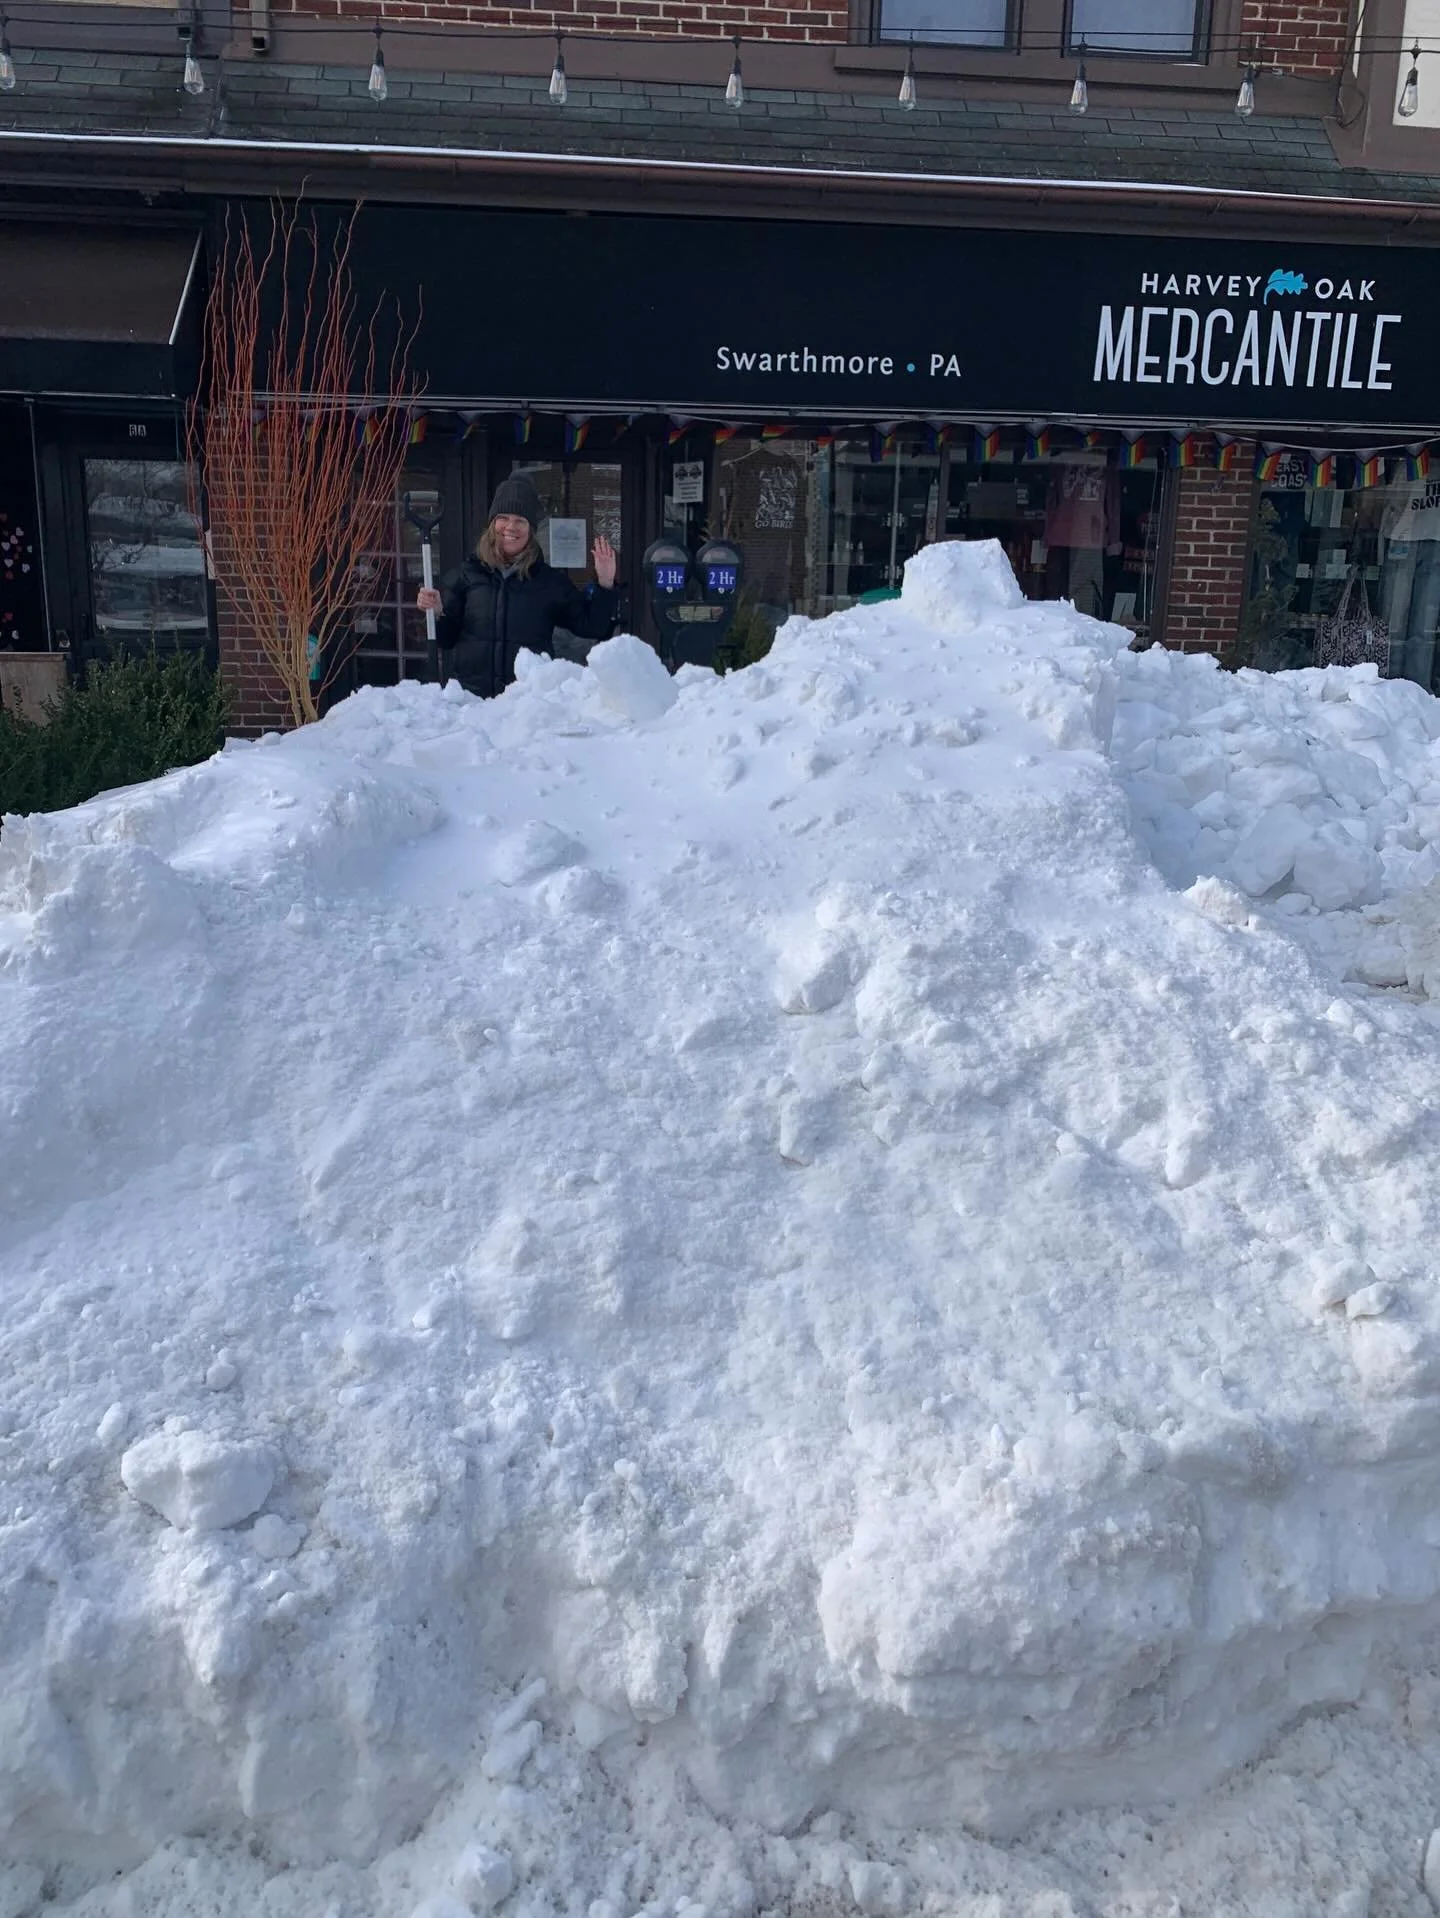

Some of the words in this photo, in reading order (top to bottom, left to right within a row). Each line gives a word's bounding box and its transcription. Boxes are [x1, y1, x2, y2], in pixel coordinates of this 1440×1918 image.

[1141, 272, 1262, 297] HARVEY
[1314, 278, 1376, 301] OAK
[1093, 305, 1402, 390] MERCANTILE
[715, 346, 893, 375] Swarthmore
[930, 353, 963, 377] PA
[1271, 473, 1308, 488] COAS
[657, 570, 664, 584] 2
[668, 570, 684, 584] Hr
[709, 571, 716, 585] 2
[720, 571, 735, 585] Hr
